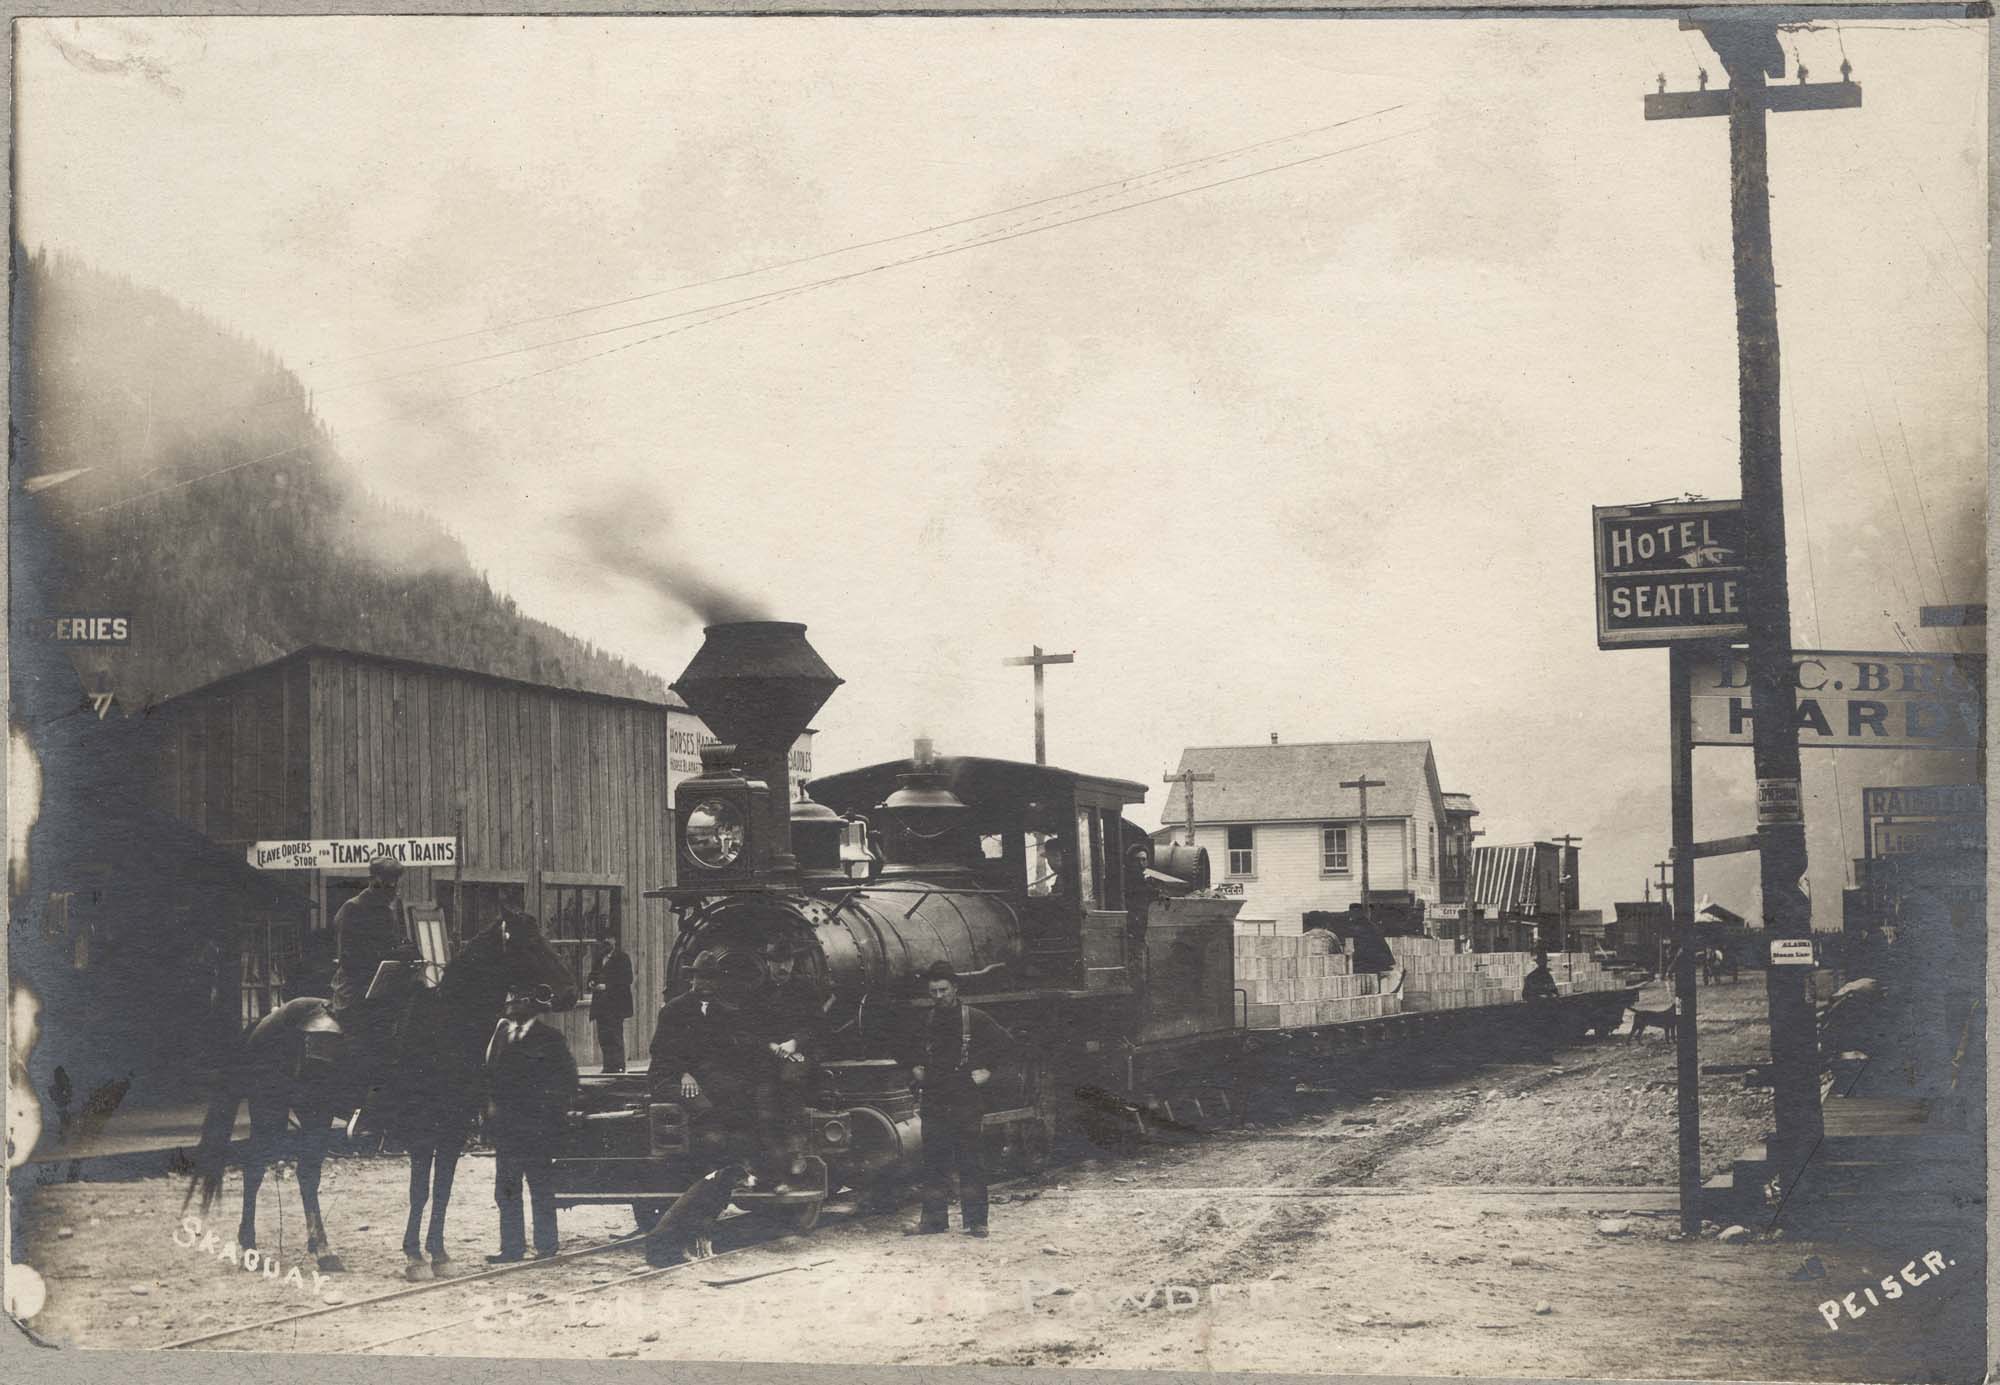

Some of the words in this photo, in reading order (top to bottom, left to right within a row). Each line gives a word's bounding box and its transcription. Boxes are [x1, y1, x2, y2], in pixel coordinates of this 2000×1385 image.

[1612, 519, 1718, 567] HOTEL
[1612, 581, 1739, 618] SEATTLE
[257, 848, 281, 867] LEAVE
[282, 842, 312, 858] ORDERS
[294, 855, 317, 866] STORE
[330, 842, 370, 863] TEAMS
[408, 840, 454, 861] TRAINS
